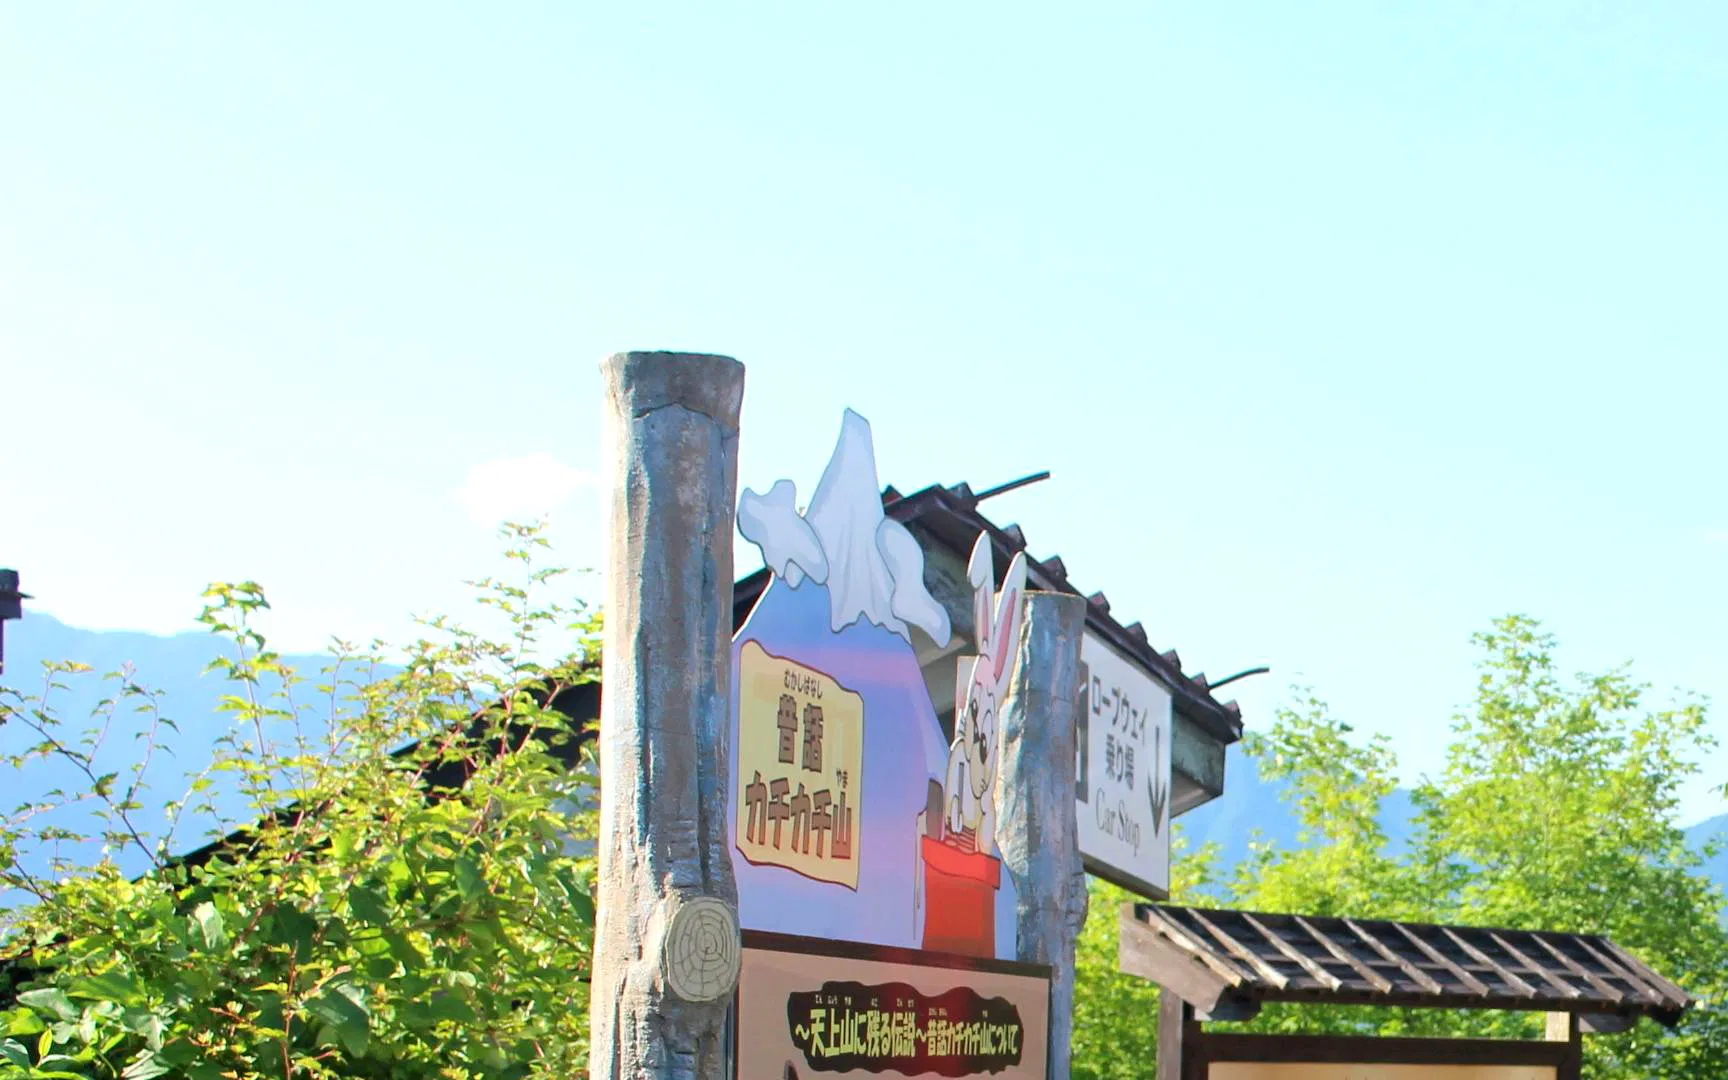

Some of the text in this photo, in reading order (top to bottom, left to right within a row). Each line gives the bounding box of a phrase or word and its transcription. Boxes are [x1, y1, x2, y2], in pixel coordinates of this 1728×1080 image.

[777, 693, 823, 773] 昔話
[1092, 675, 1148, 747] ロープウェイ
[1105, 733, 1135, 791] 乗り場
[745, 770, 852, 860] カチカチ山
[1096, 787, 1141, 857] Car Stop
